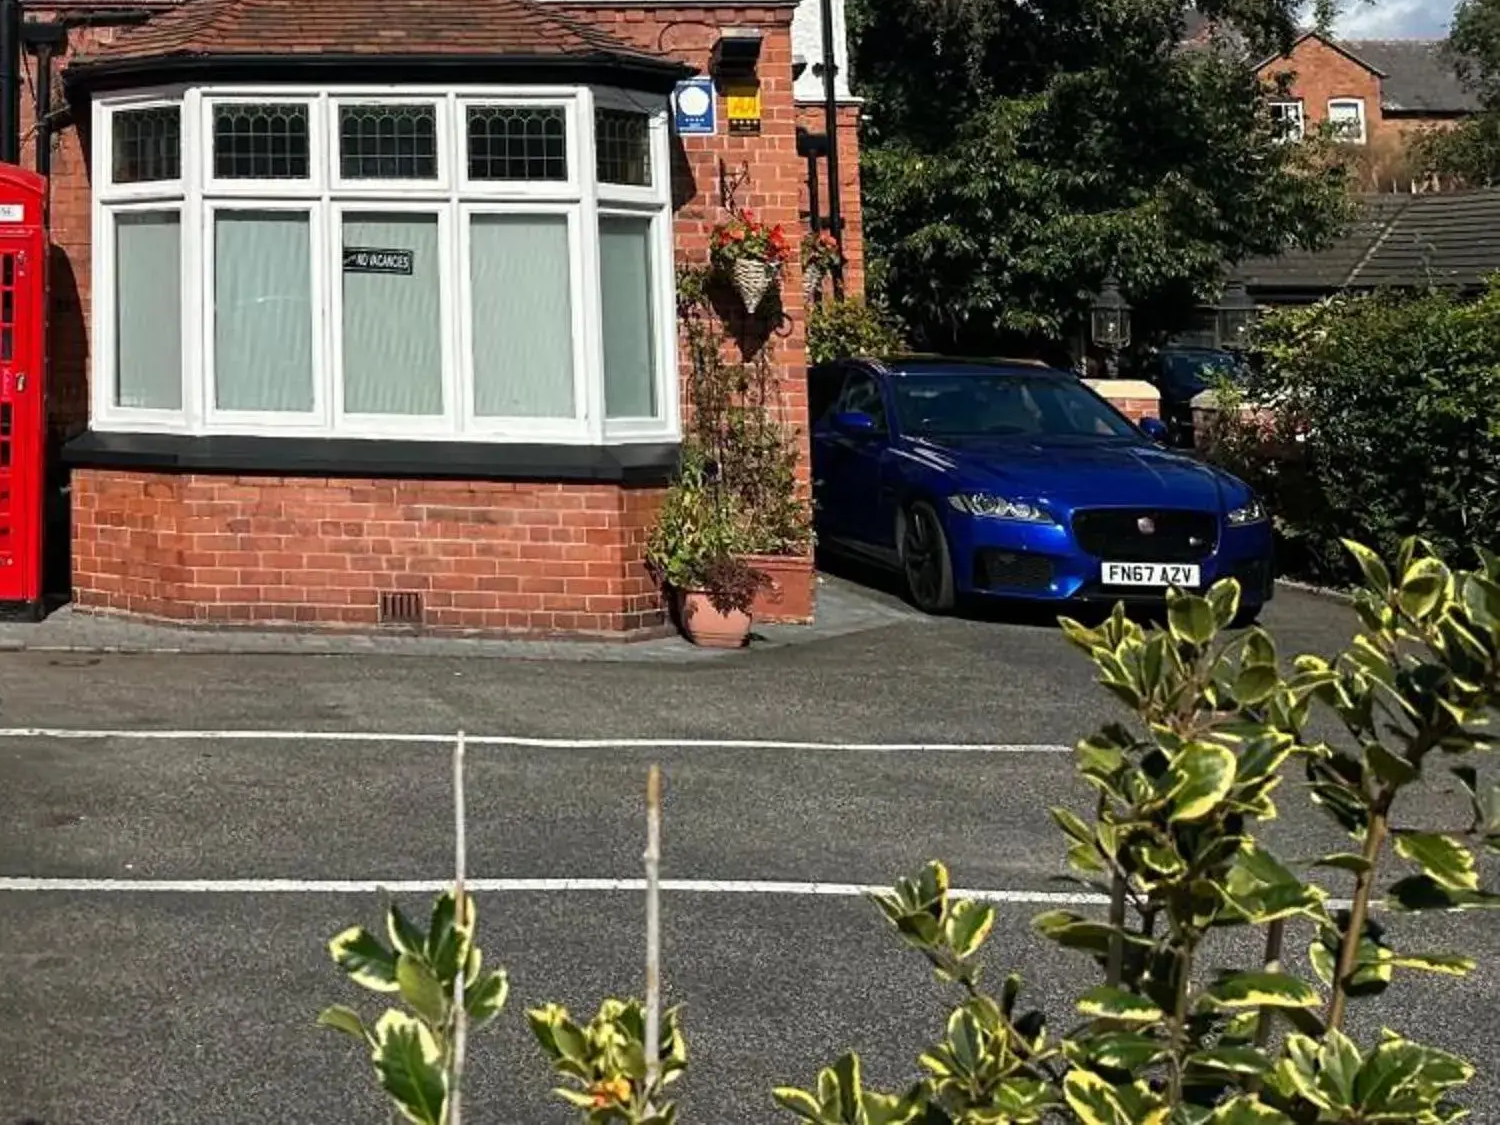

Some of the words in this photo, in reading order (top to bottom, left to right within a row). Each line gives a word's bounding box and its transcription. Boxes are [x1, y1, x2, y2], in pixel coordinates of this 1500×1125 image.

[356, 253, 368, 266] NO
[370, 254, 409, 268] VACANCIES
[1109, 565, 1155, 582] FN67
[1160, 567, 1191, 583] AZV
